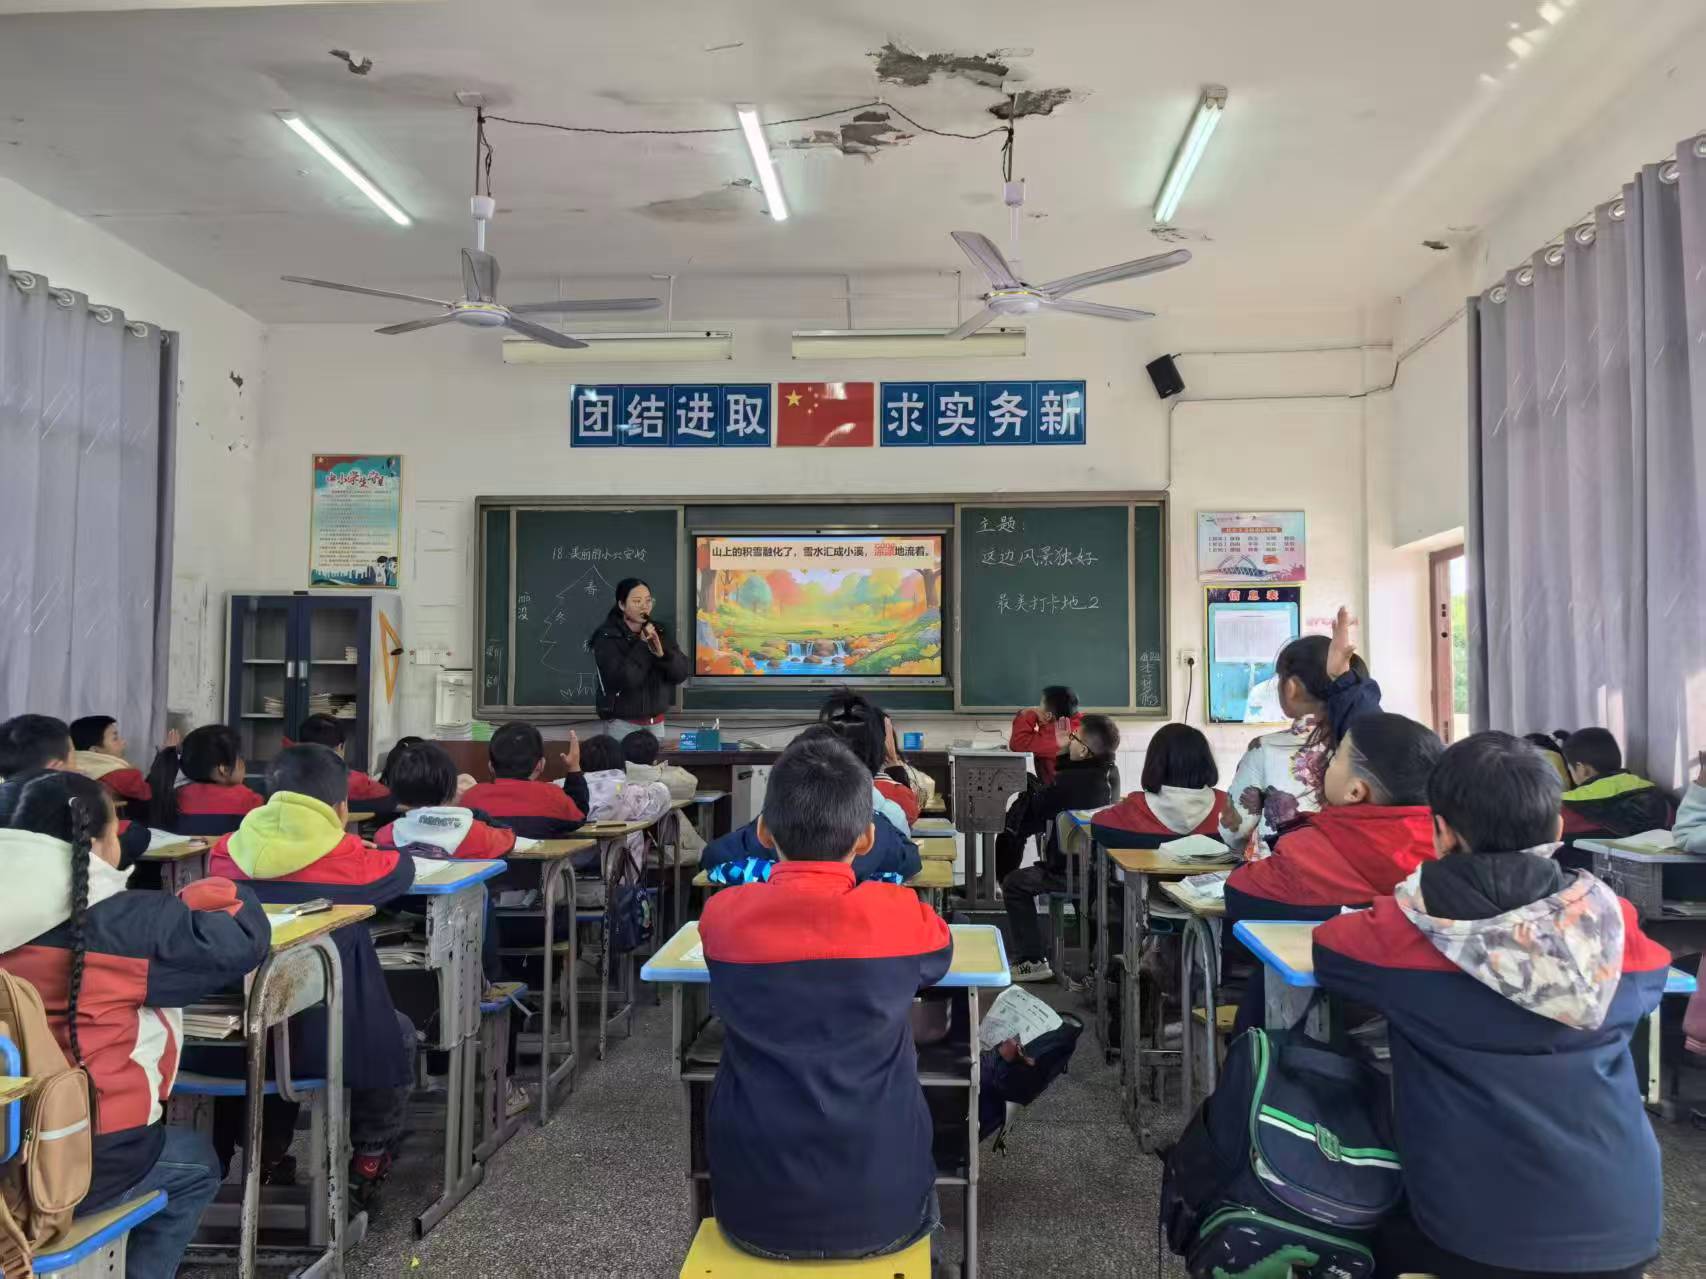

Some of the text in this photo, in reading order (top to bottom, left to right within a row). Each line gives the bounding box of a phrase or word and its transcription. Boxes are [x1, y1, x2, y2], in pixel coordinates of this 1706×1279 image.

[578, 392, 766, 438] 团结进取
[887, 389, 1080, 437] 求实务新
[981, 545, 1098, 567] 这边风景独好
